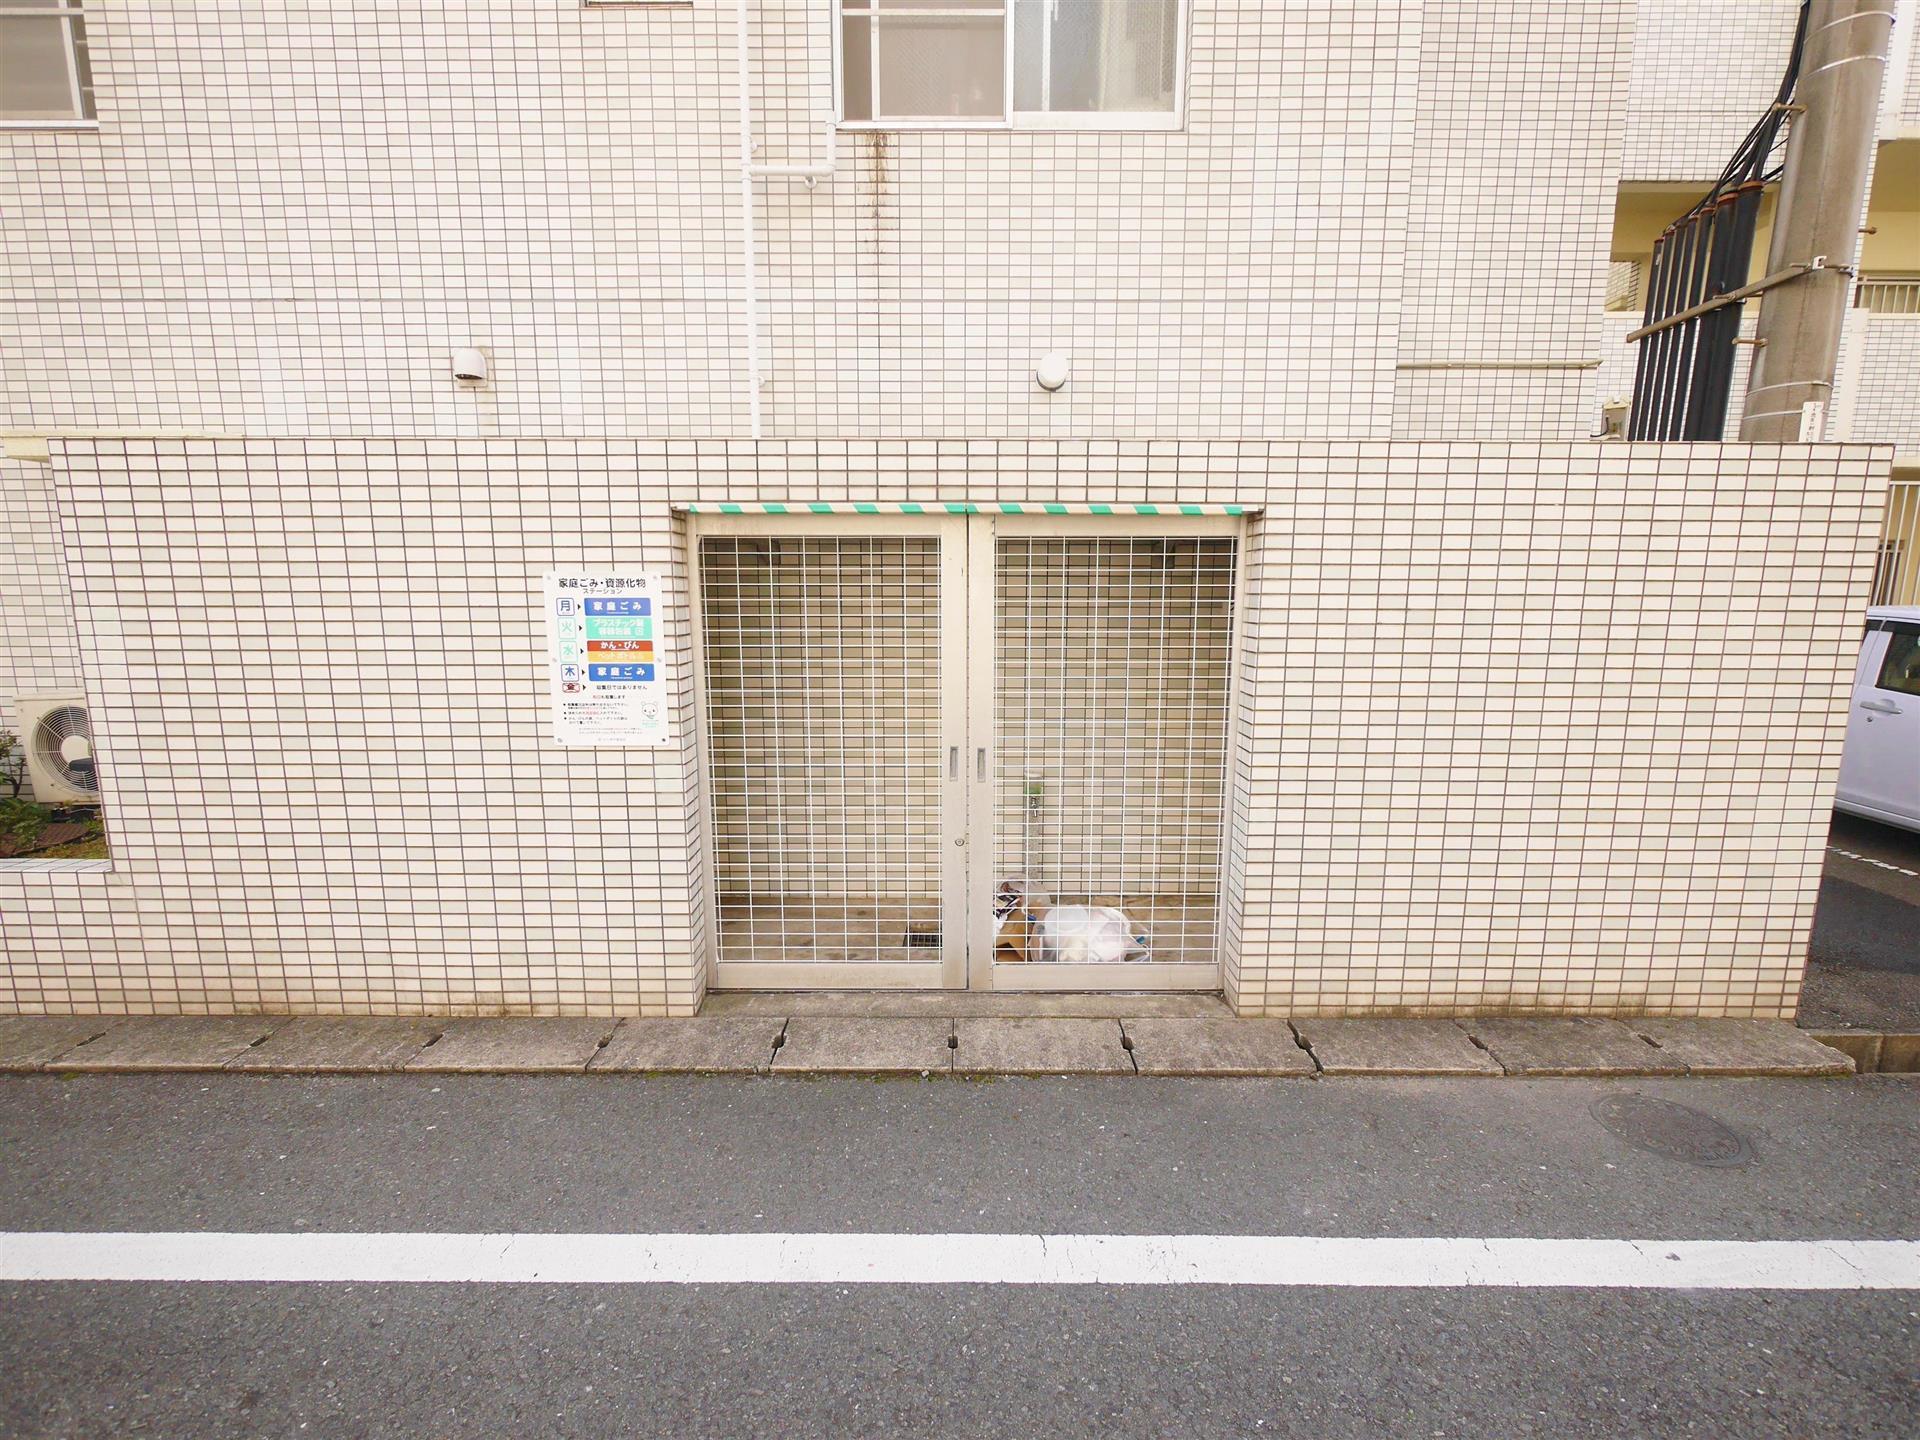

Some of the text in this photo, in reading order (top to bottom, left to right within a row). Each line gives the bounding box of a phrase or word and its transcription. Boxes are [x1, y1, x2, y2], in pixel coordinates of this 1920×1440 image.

[559, 578, 646, 588] 家庭ごみ・資源化物
[560, 600, 571, 611] 月
[593, 601, 642, 611] 家庭ごみ
[561, 622, 573, 633] 火
[600, 641, 639, 649] かん・びん
[563, 645, 574, 656] 水
[564, 666, 576, 677] 木
[597, 667, 646, 676] 家庭ごみ
